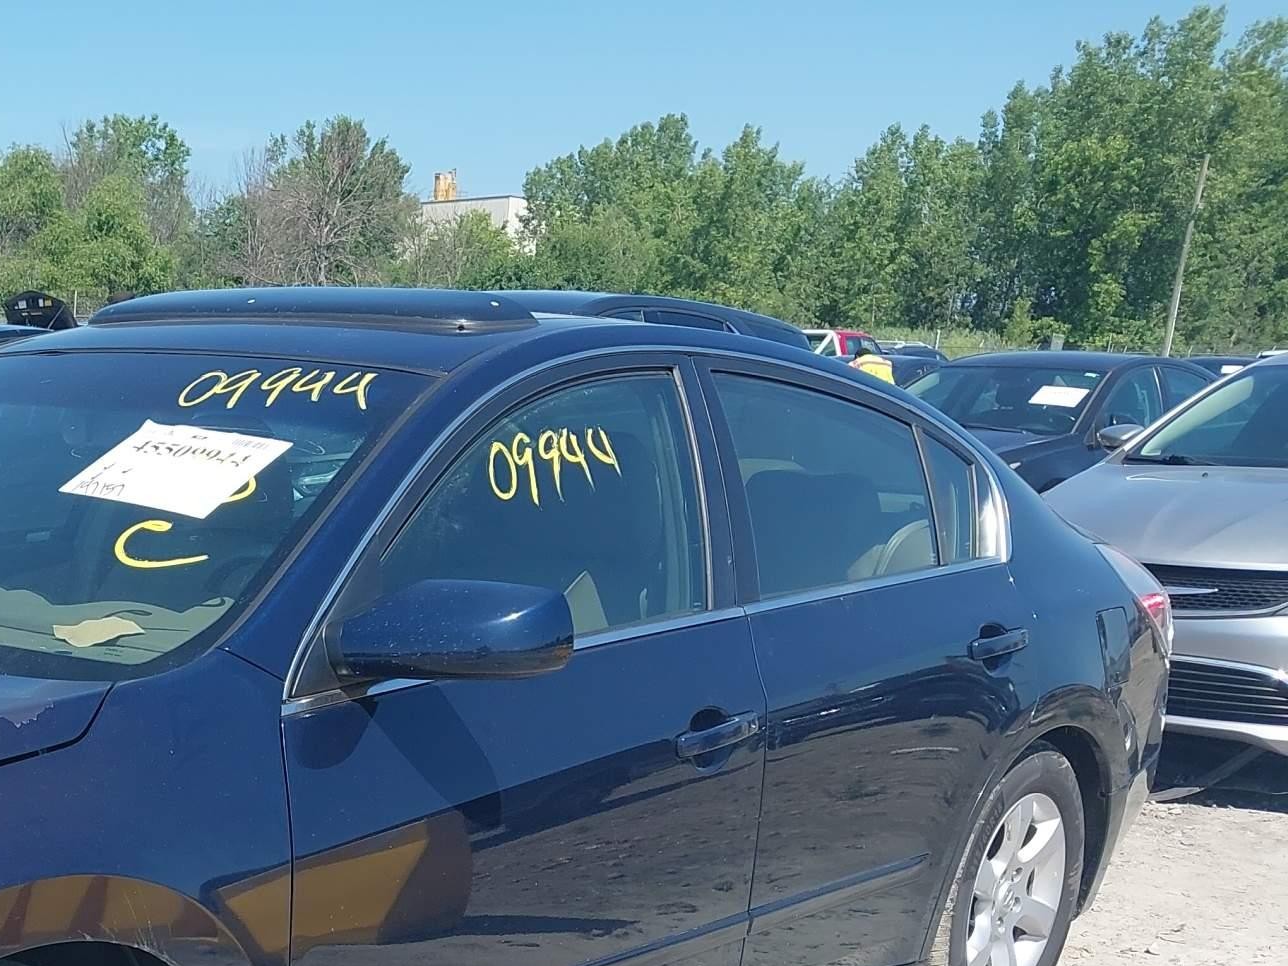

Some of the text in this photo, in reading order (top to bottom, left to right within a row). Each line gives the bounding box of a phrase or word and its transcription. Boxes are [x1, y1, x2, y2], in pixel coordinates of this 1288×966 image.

[178, 367, 379, 410] 09944
[488, 425, 623, 507] 09944
[113, 519, 209, 569] C
